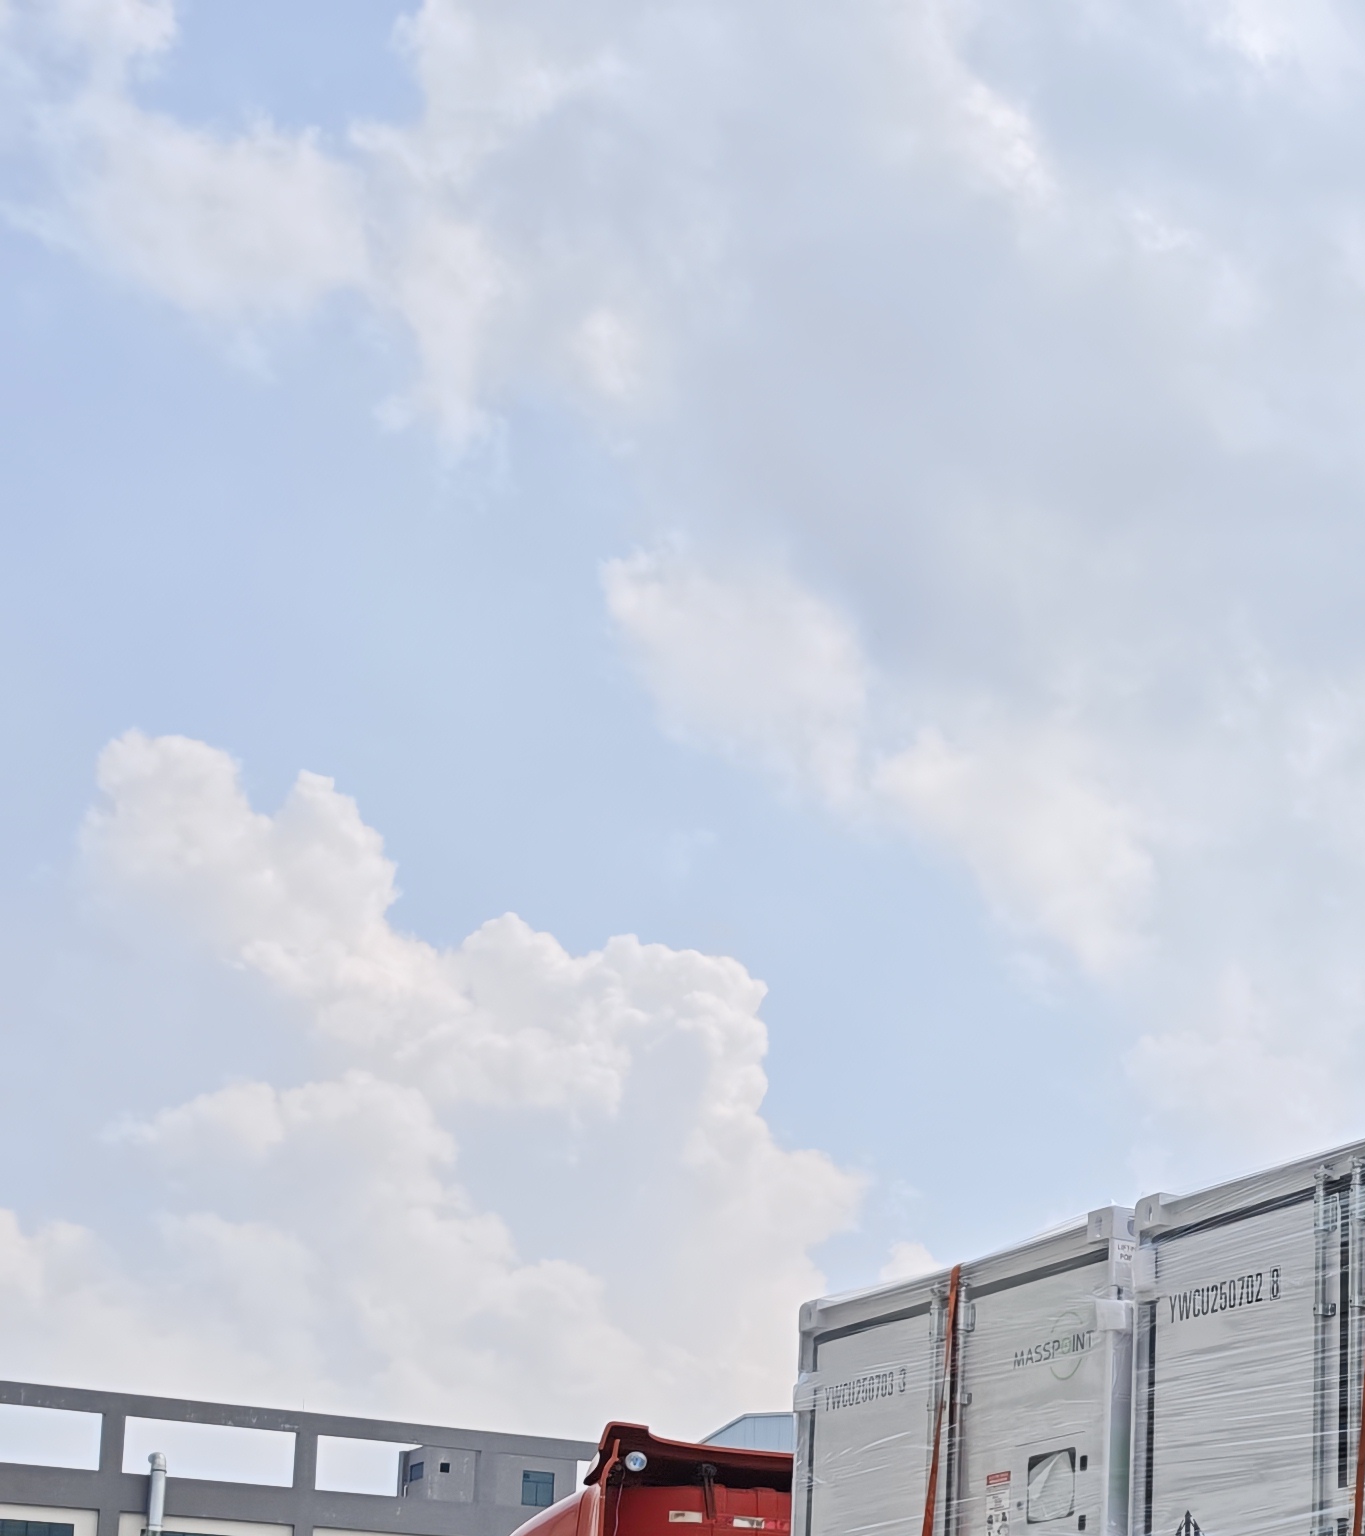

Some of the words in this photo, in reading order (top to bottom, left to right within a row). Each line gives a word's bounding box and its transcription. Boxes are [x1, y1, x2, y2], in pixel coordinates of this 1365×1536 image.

[1169, 1272, 1263, 1323] YWCU250702
[1271, 1268, 1279, 1298] 8
[1013, 1330, 1094, 1369] MASSPOINT
